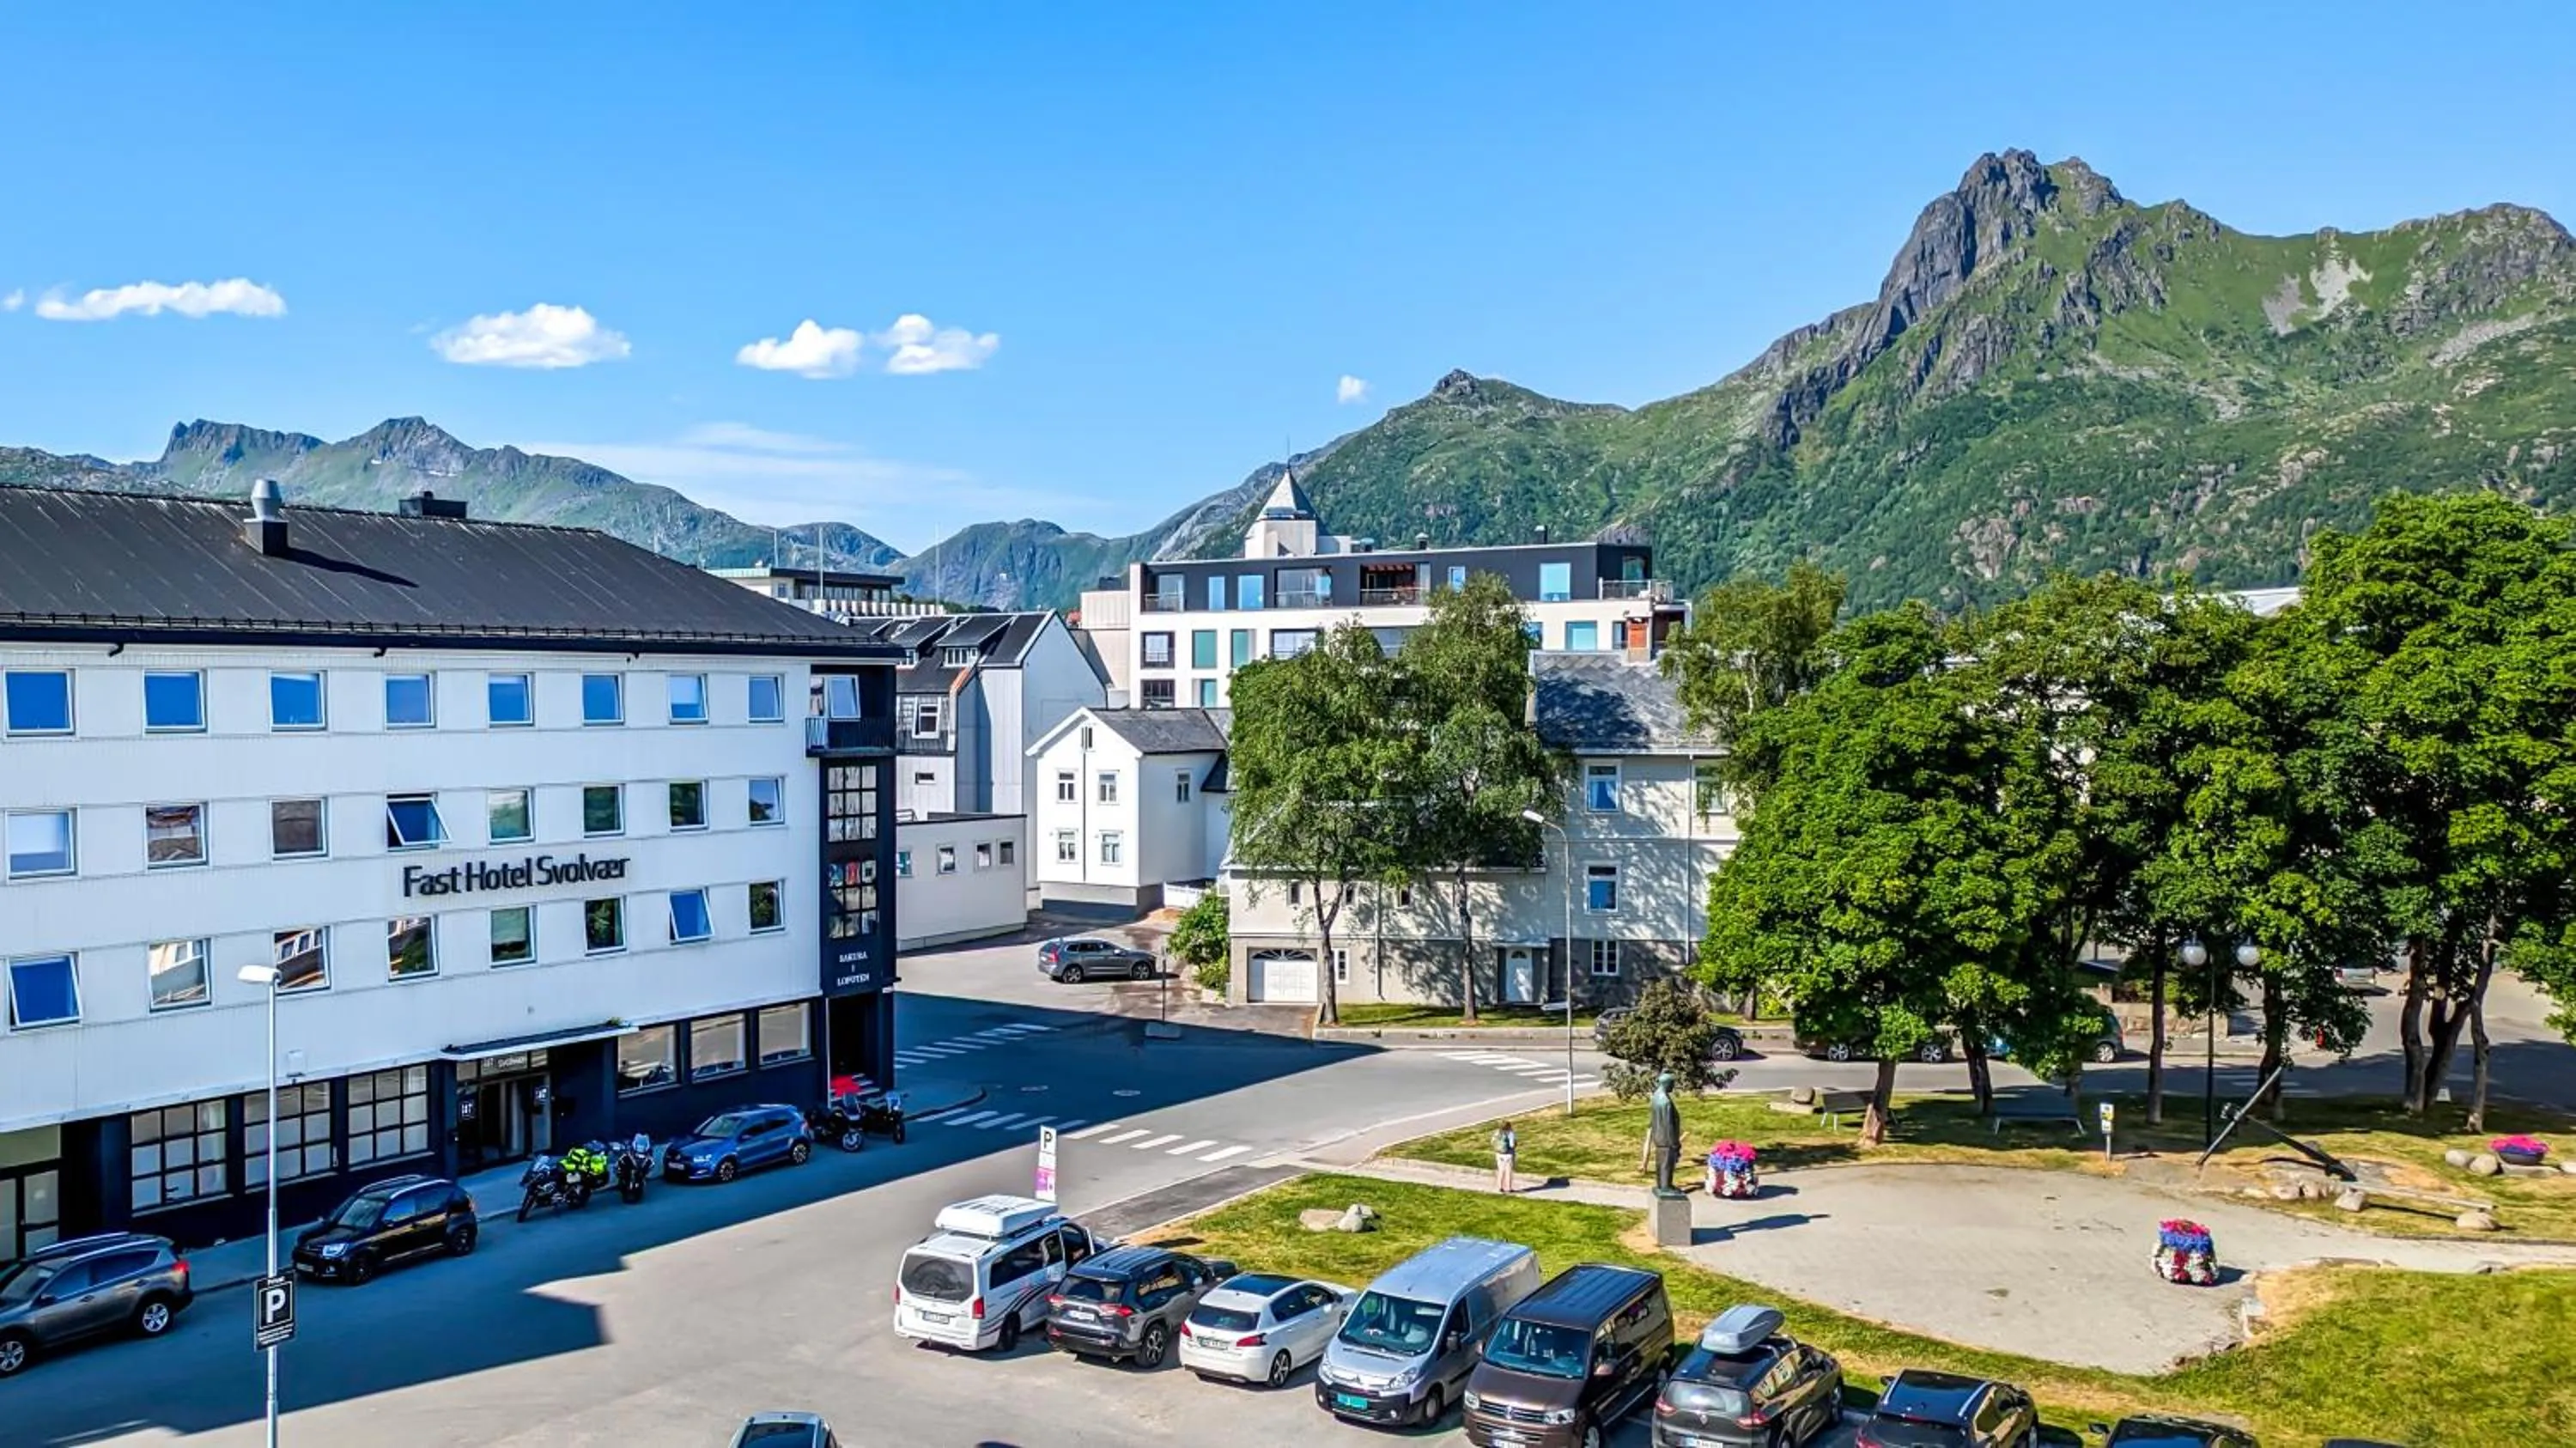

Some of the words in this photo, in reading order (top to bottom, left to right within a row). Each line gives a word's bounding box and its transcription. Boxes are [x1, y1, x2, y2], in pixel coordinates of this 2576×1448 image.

[404, 866, 462, 897] Fast
[465, 858, 532, 891] Hotel
[536, 854, 630, 885] Svolvær
[1043, 1130, 1053, 1149] P
[266, 1288, 286, 1323] P
